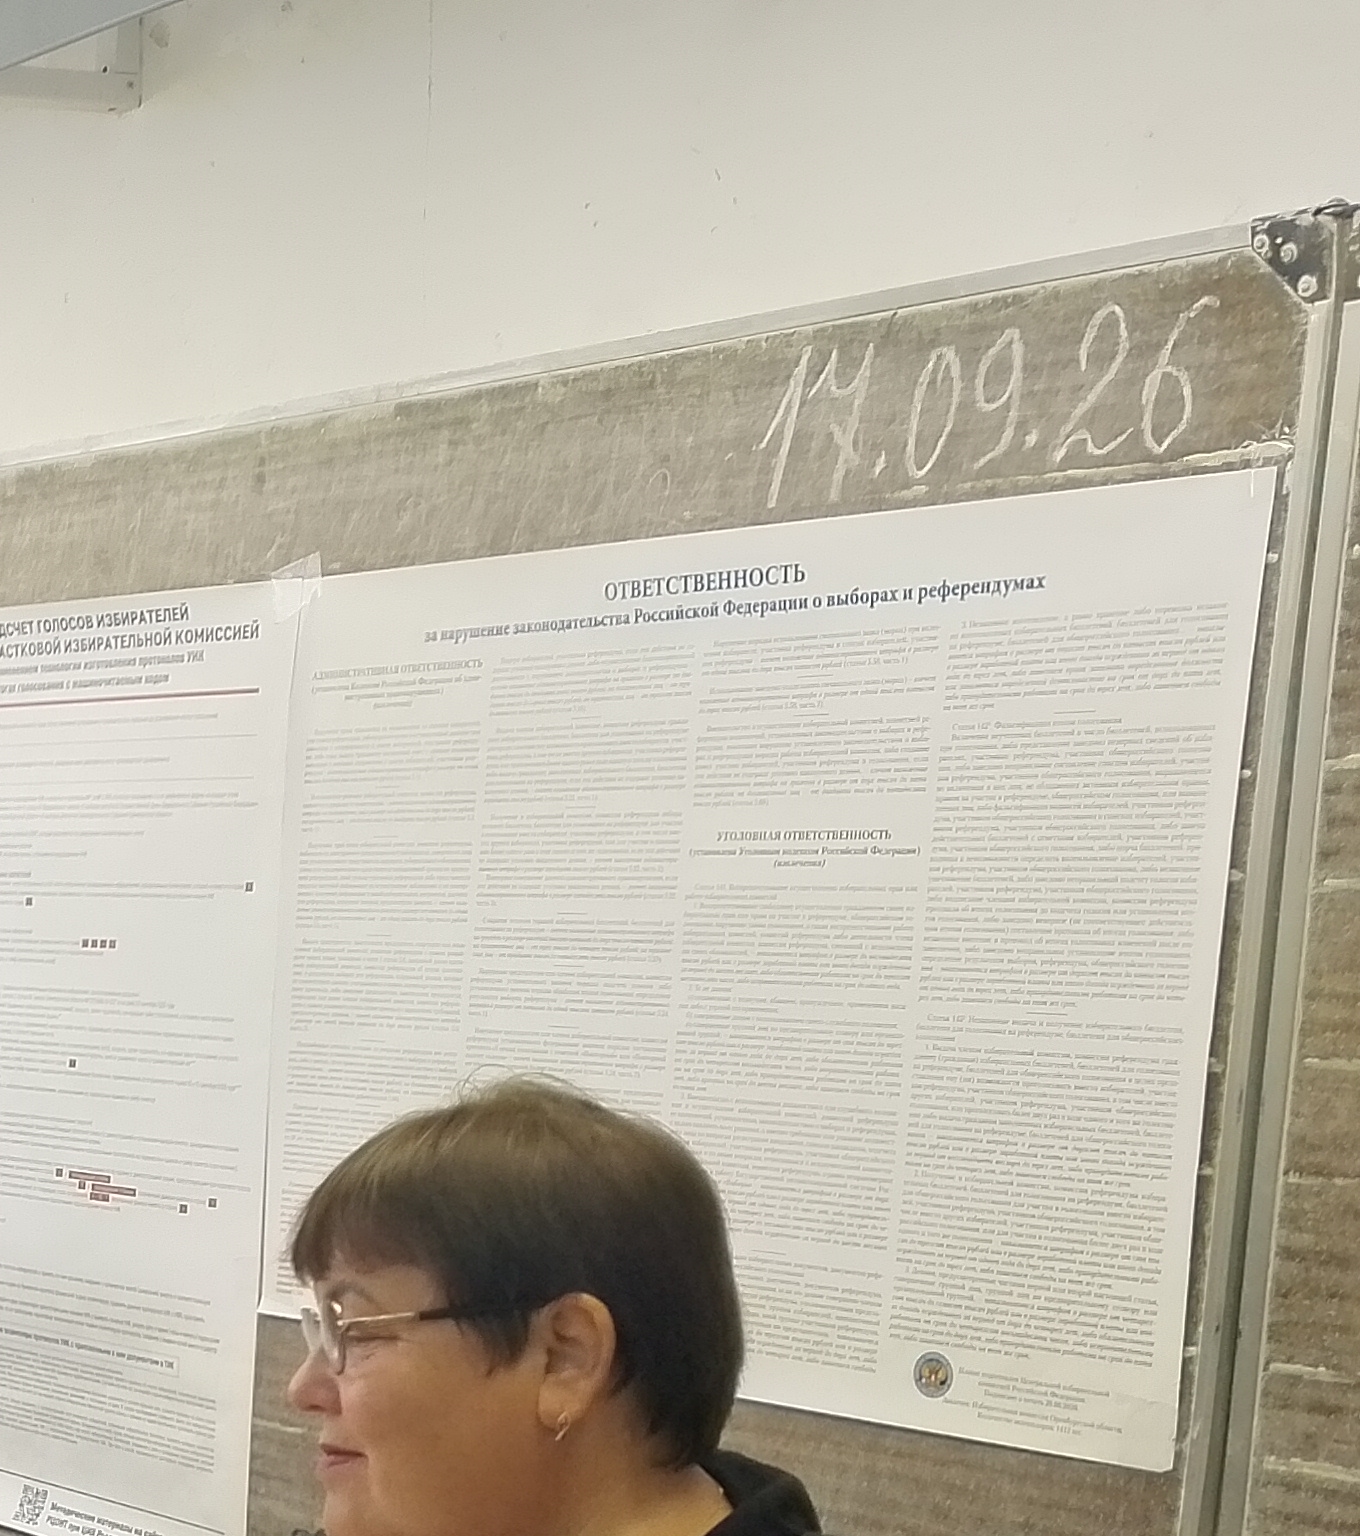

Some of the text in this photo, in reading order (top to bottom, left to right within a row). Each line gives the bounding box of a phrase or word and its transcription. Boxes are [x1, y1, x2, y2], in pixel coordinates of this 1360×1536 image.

[604, 562, 807, 601] ОТВЕТСТВЕННОСТЬ
[36, 614, 94, 635] ГОЛОСОВ
[95, 601, 190, 629] ИЗБИРАТЕЛЕЙ
[424, 574, 1047, 645] за нарушение законодательства Российской Федерации о выборах и референдумах
[63, 626, 172, 654] ИЗБИРАТЕЛЬНОЙ
[175, 618, 261, 646] КОМИССИЕЙ
[717, 828, 893, 842] УГОЛОВНАЯ ОТВЕТСТВЕННОСТЬ
